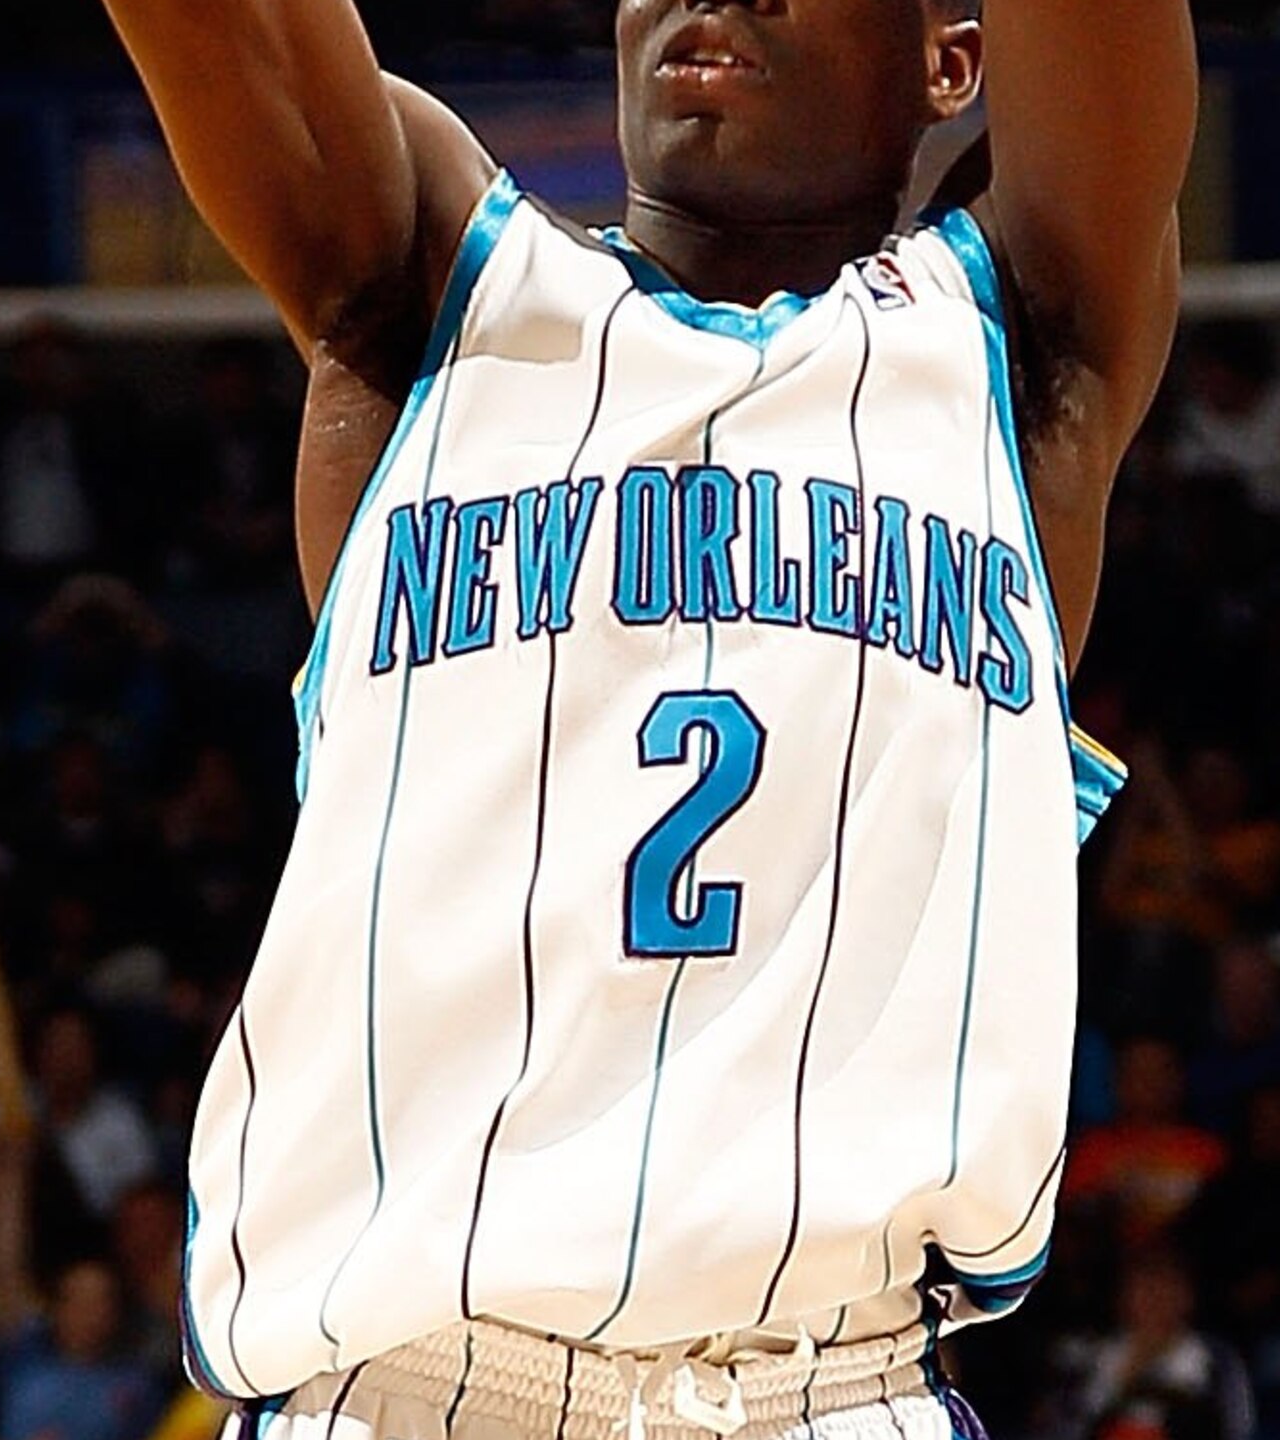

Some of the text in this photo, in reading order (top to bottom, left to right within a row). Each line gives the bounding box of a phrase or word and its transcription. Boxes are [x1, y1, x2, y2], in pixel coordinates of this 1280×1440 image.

[370, 465, 1033, 715] NEW ORLEANS
[623, 689, 767, 959] 2
